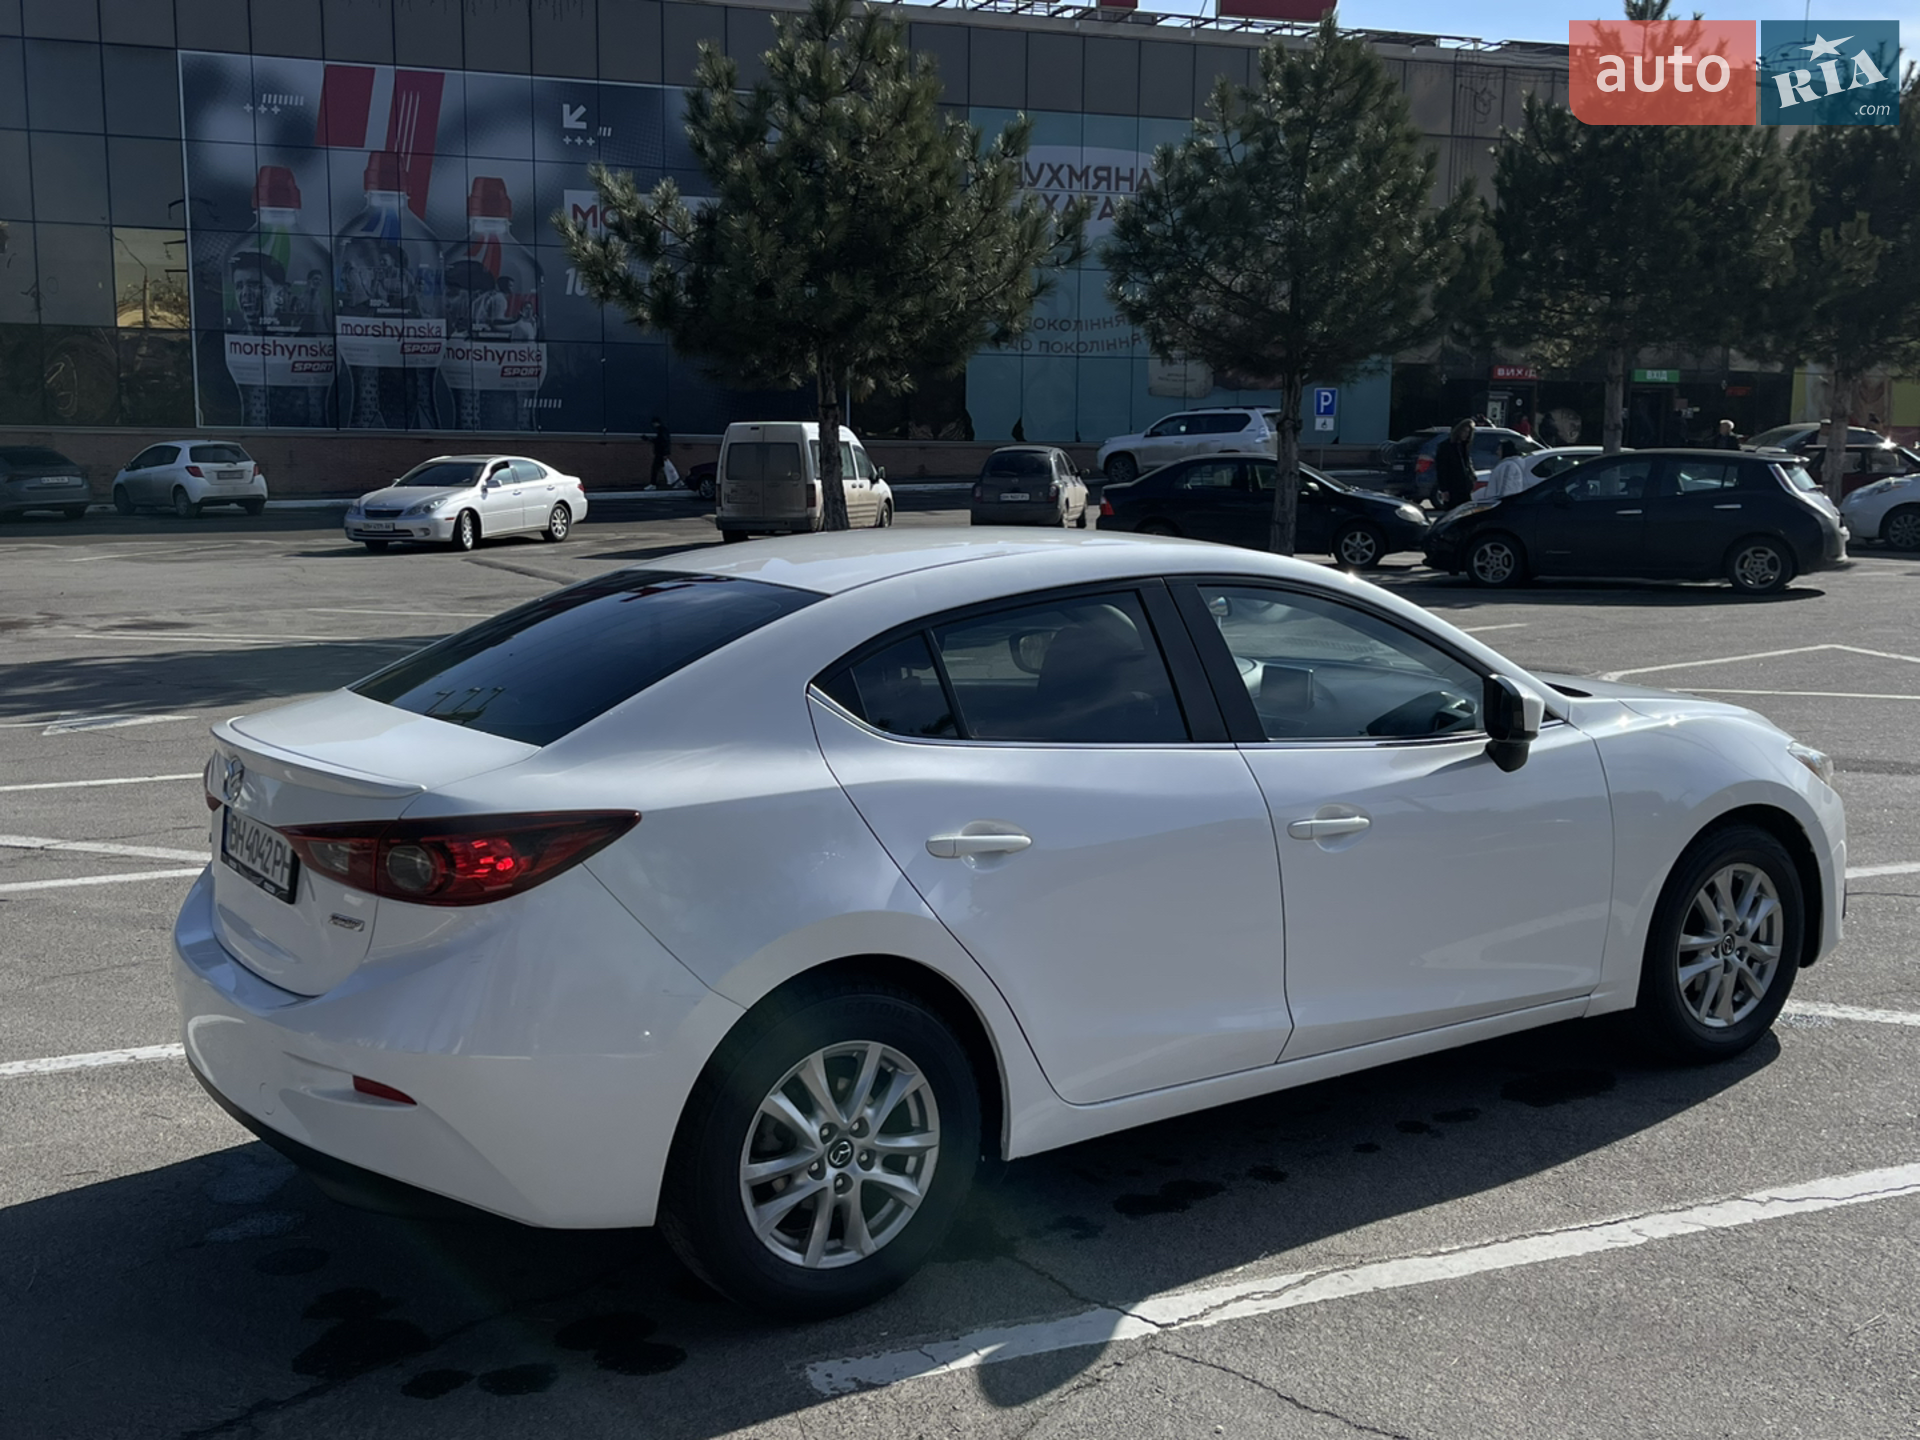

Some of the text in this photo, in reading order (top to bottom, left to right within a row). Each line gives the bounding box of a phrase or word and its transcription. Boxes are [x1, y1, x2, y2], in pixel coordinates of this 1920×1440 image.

[341, 321, 443, 342] morshynska
[229, 339, 334, 361] morshynska
[403, 343, 442, 353] SPORT
[1038, 333, 1143, 354] ПОКОЛІННЯ
[293, 362, 334, 372] SPORT
[502, 367, 542, 377] SPORT
[1320, 391, 1333, 413] P
